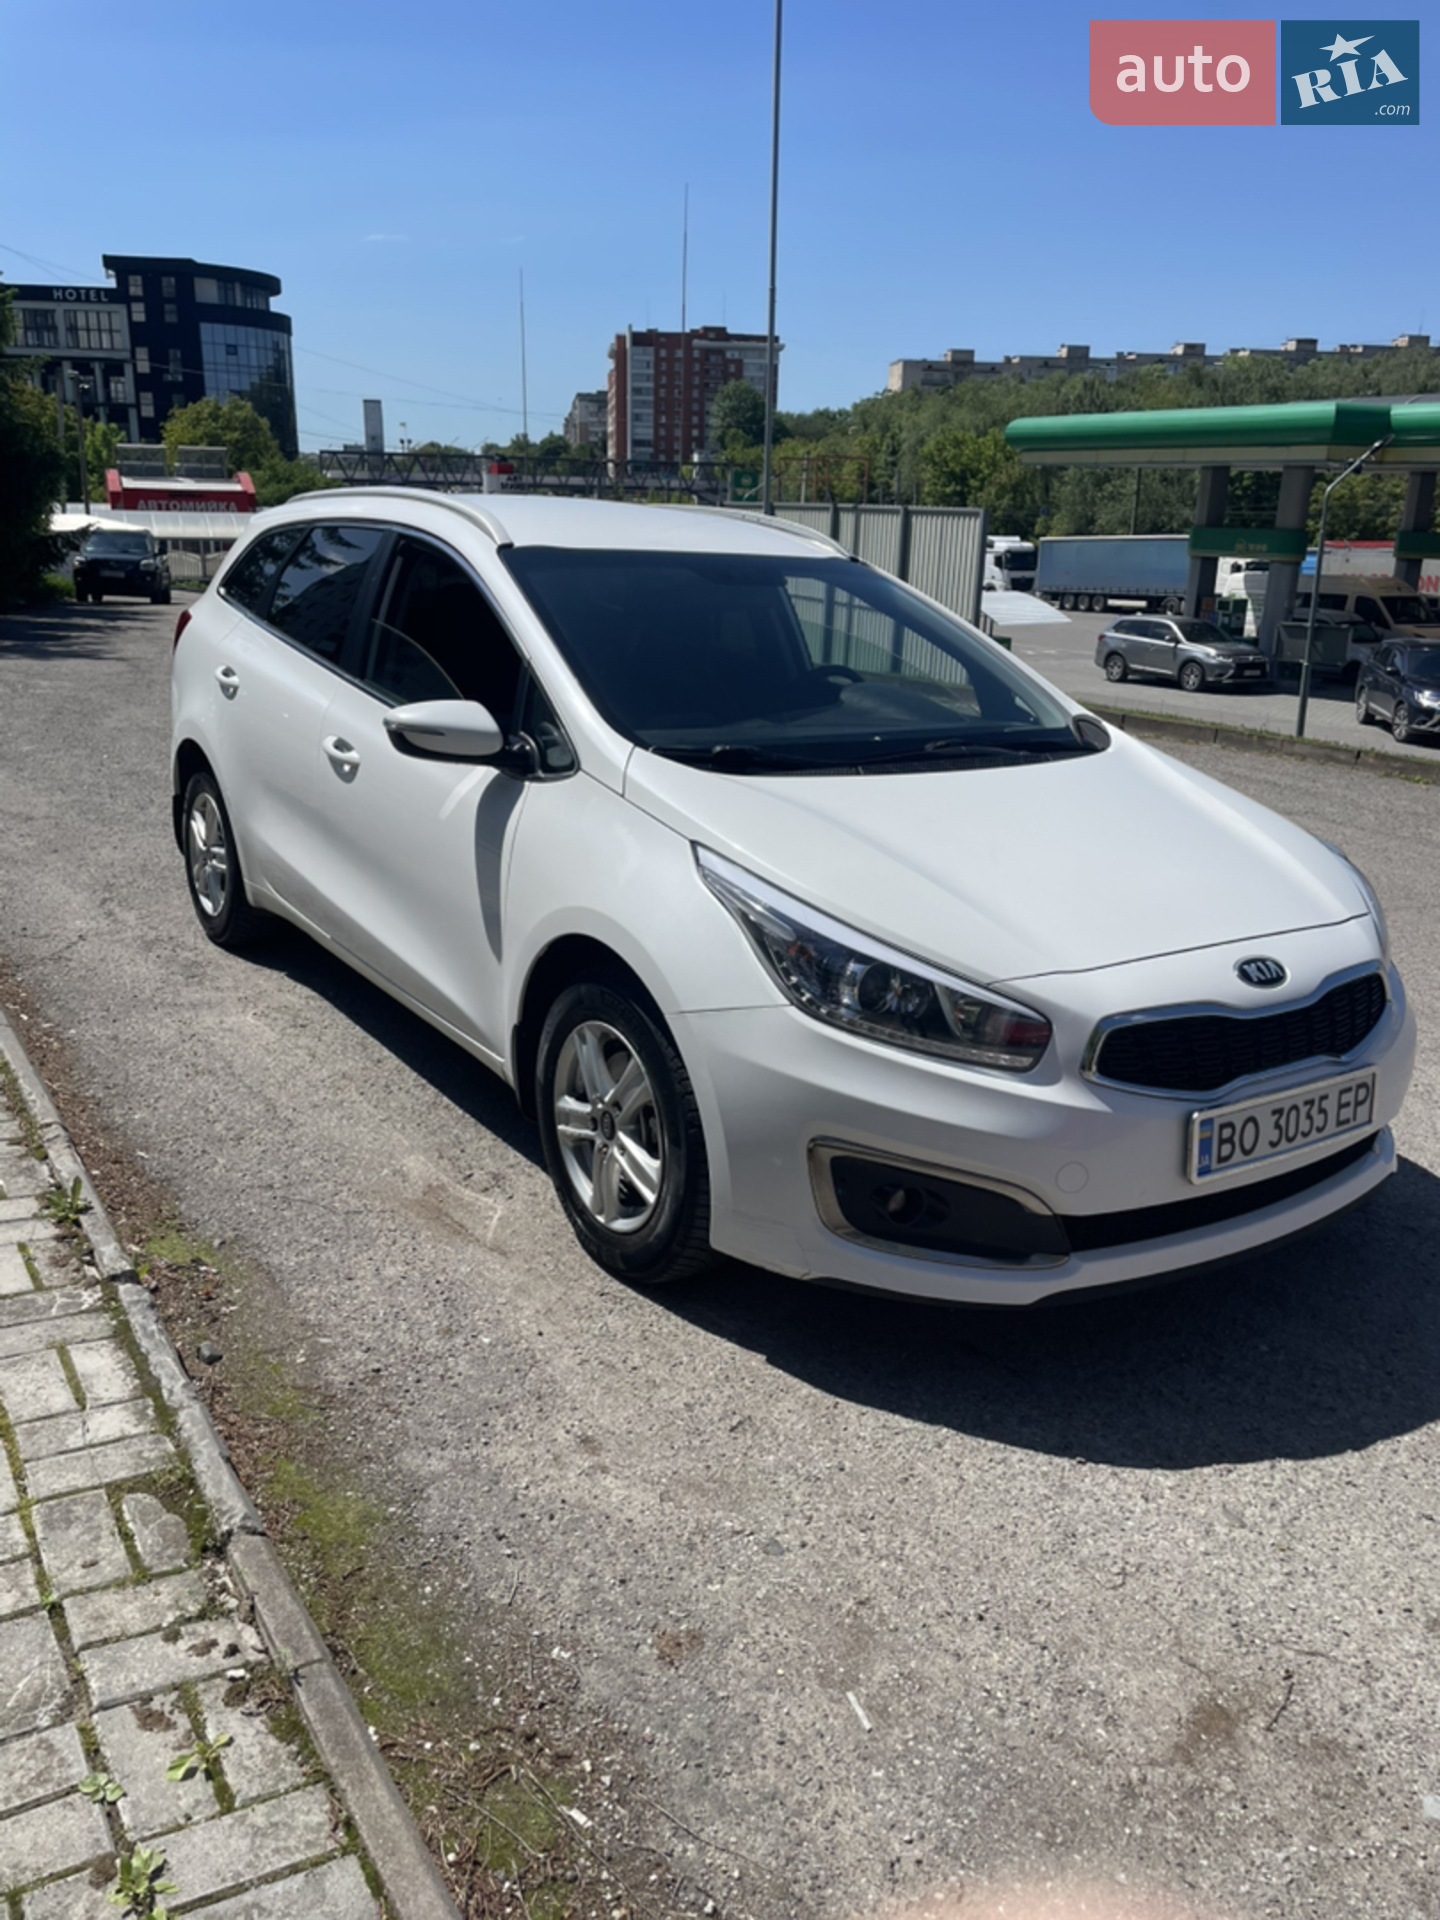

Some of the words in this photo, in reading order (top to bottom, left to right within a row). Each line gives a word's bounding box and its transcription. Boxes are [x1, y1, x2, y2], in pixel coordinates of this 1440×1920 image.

[53, 288, 109, 301] HOTEL
[1242, 961, 1284, 982] KIA
[1217, 1115, 1260, 1165] BO
[1268, 1094, 1329, 1149] 3035
[1336, 1081, 1370, 1128] EP
